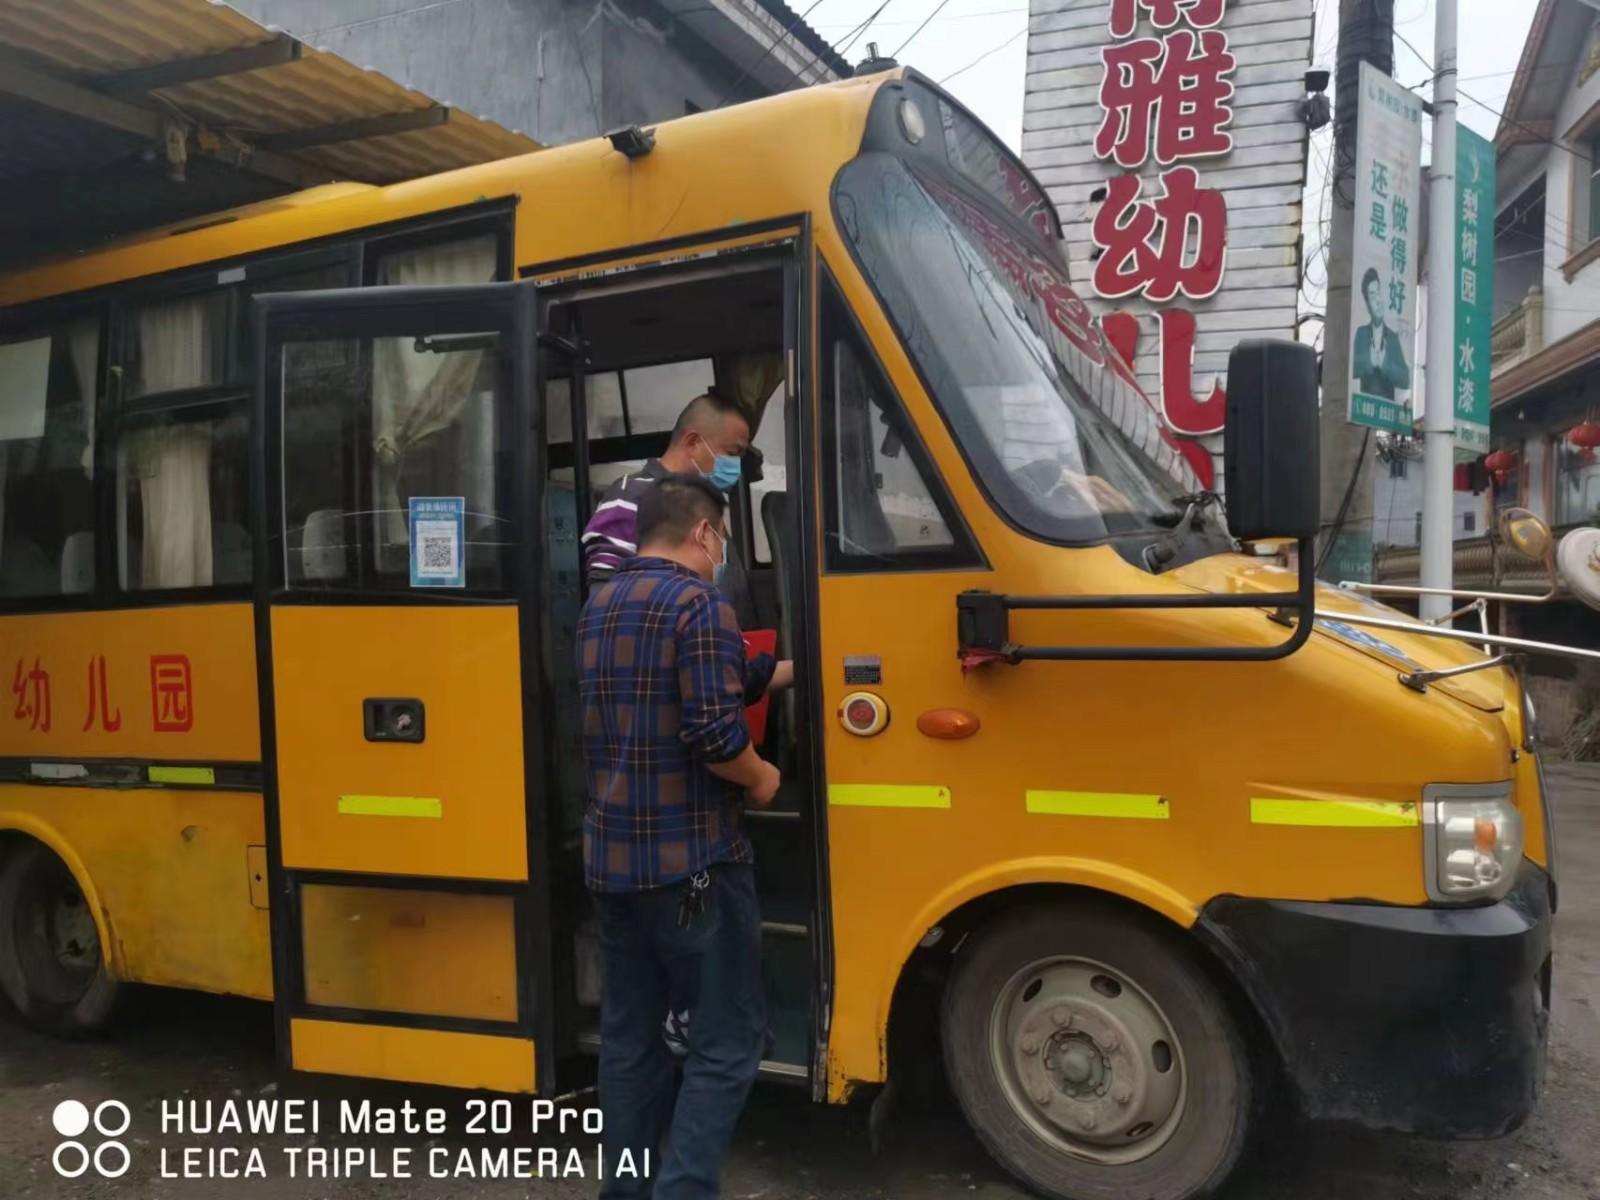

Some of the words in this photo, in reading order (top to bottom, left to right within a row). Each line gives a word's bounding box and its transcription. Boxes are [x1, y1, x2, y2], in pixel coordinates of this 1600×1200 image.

[1370, 158, 1389, 241] 还是
[1388, 194, 1409, 315] 做得好
[12, 654, 194, 734] 幼儿园
